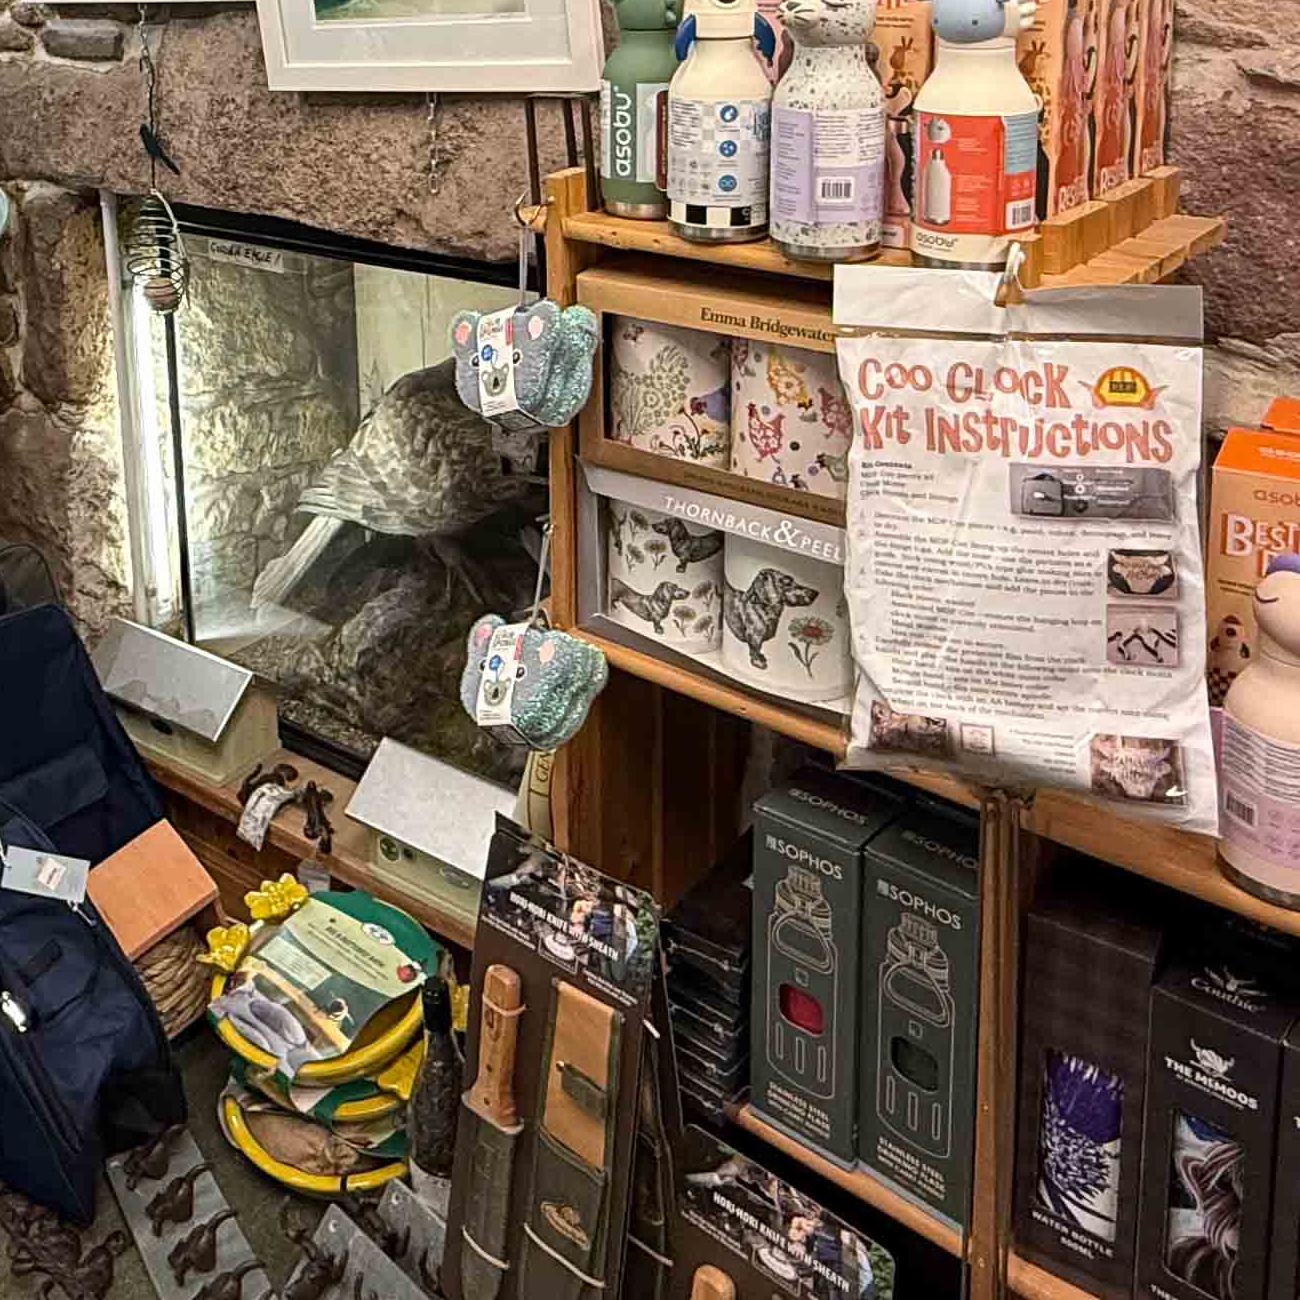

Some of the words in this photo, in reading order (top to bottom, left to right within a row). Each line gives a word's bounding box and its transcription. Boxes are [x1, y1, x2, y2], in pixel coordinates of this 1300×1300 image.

[612, 92, 632, 177] asobu
[915, 232, 955, 248] asobu
[700, 306, 747, 328] Emma
[750, 315, 839, 343] Bridgewater
[1253, 488, 1300, 507] asob
[663, 496, 772, 540] THORNBACK
[773, 519, 801, 549] &
[800, 537, 844, 561] PEEL
[1221, 513, 1300, 557] BEST
[801, 789, 869, 826] SOPHOS
[776, 838, 844, 881] SOPHOS
[913, 834, 980, 870] SOPHO
[888, 883, 962, 931] SOPHOS
[1163, 1055, 1193, 1079] THE
[712, 1191, 759, 1229] HORI-HORI
[759, 1222, 786, 1249] KNIFE
[786, 1241, 812, 1268] WITH
[812, 1258, 851, 1293] SHEATH
[1031, 1210, 1069, 1237] WATER
[1070, 1229, 1114, 1258] BOTTLE
